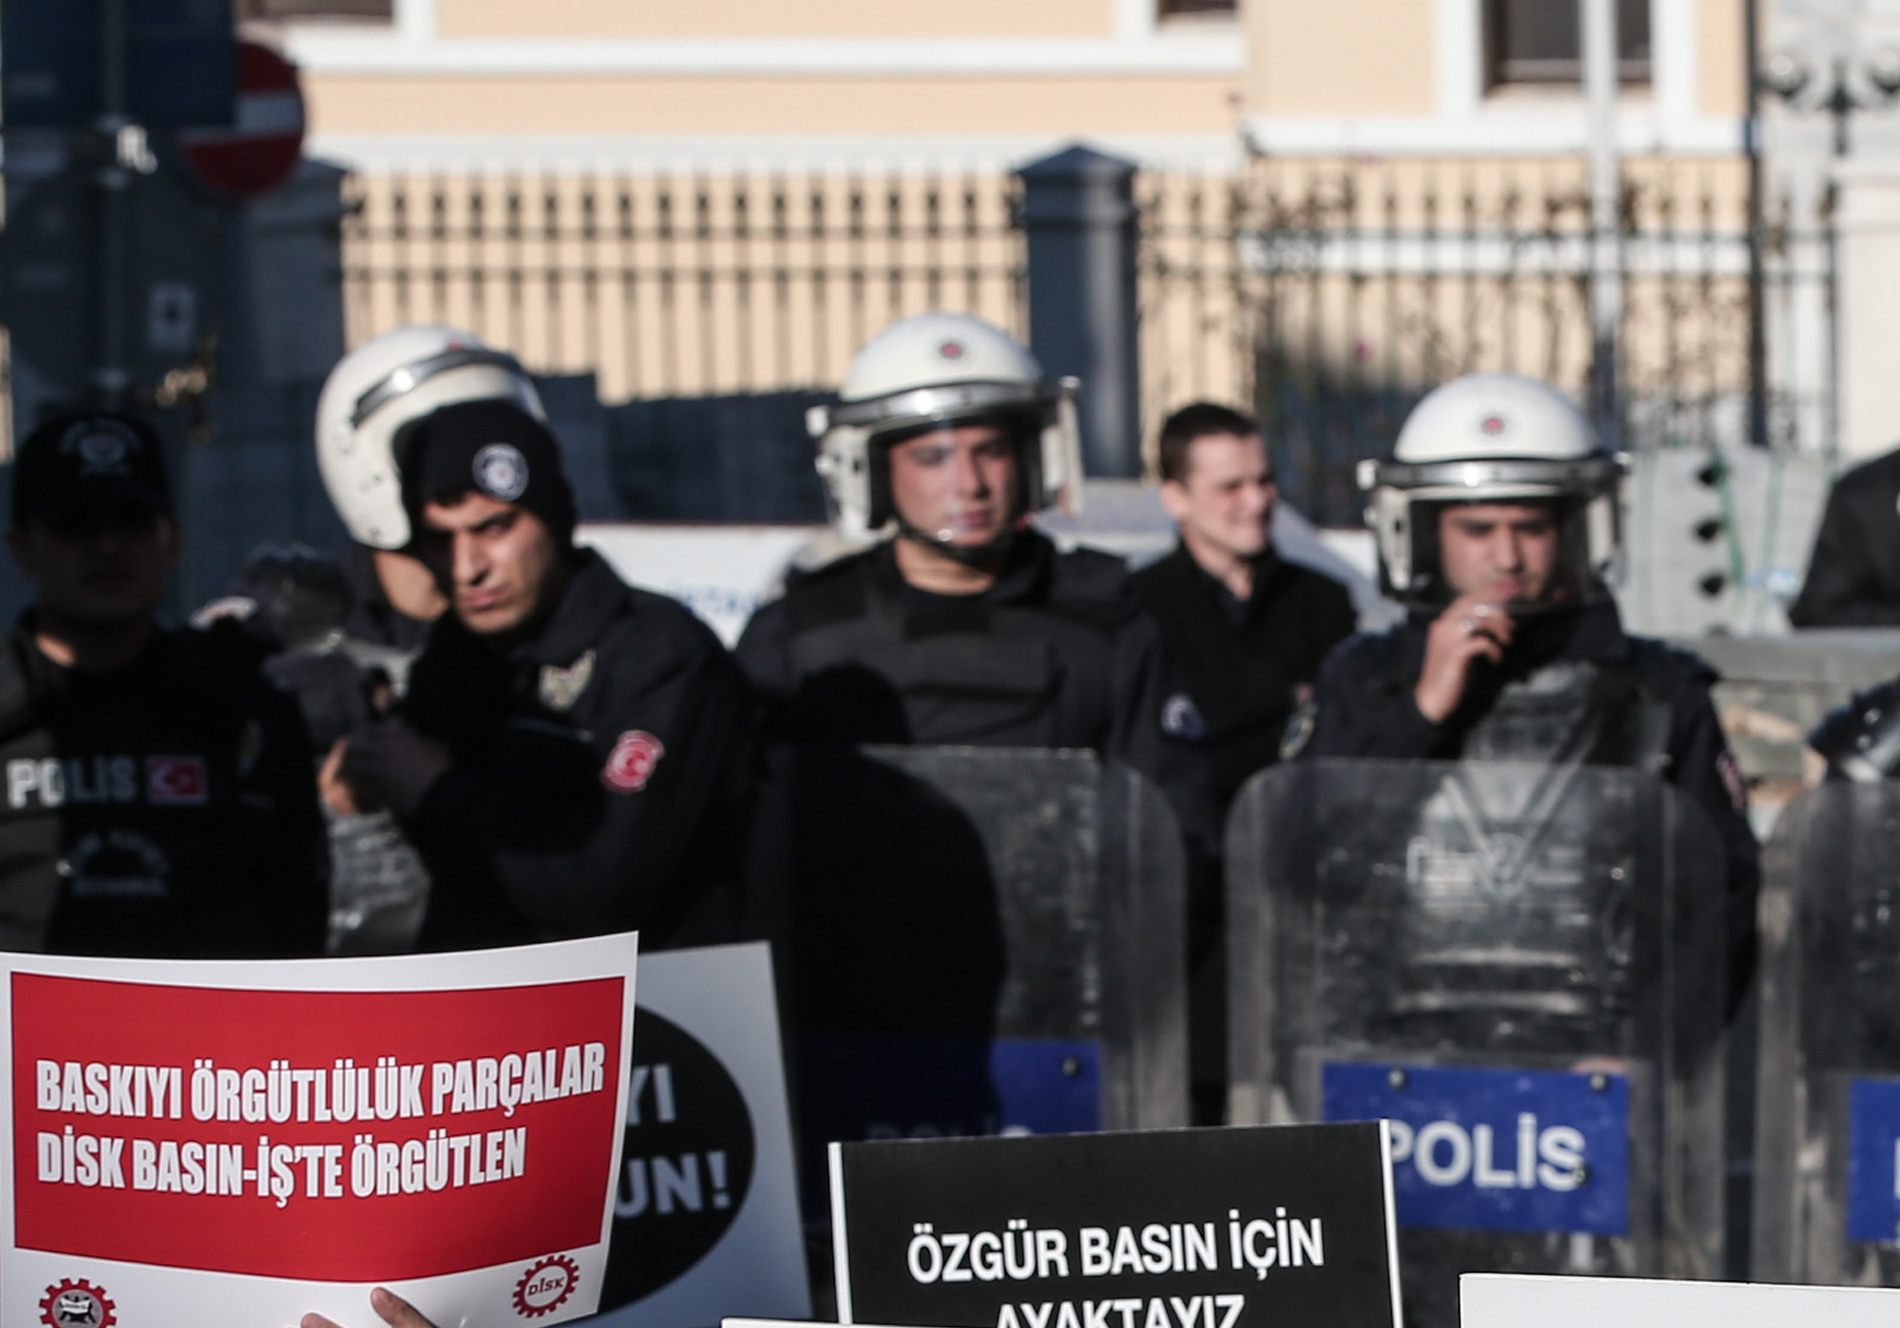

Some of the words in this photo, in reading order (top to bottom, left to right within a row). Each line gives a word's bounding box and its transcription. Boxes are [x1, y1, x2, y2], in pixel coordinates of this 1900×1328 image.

[36, 1059, 183, 1120] BASKIYI
[190, 1056, 425, 1123] ÖRGÜTLÜLÜK
[431, 1041, 606, 1118] PARÇALAR
[37, 1125, 126, 1189] DİSK
[350, 1127, 527, 1198] ÖRGÜTLEN
[907, 1218, 1070, 1284] ÖZGÜR
[1079, 1222, 1218, 1277] BASIN
[1228, 1206, 1325, 1281] İÇİN
